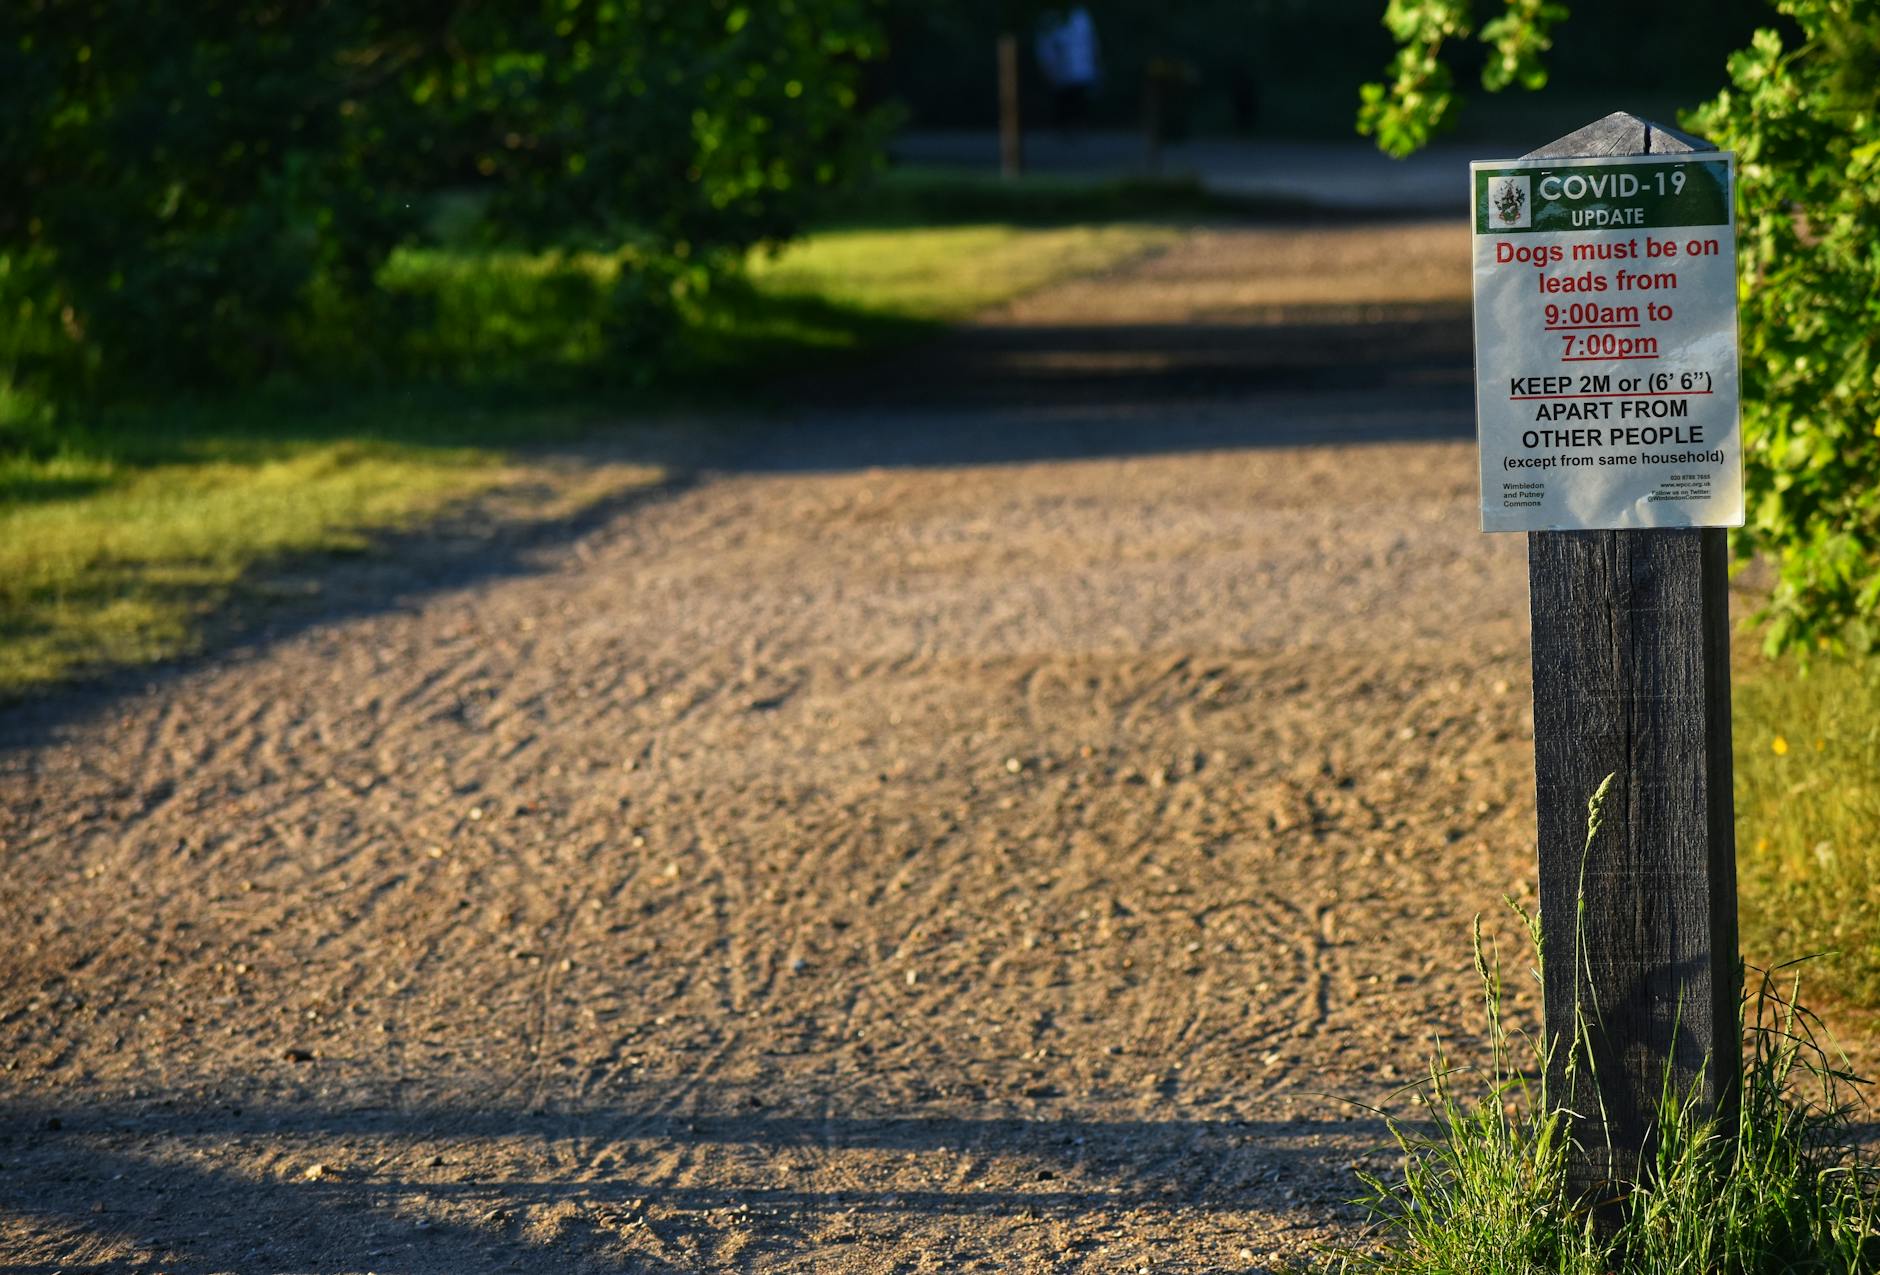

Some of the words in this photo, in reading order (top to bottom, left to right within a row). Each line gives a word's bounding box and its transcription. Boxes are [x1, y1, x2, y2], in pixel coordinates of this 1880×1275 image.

[1539, 171, 1687, 201] COVID-19
[1571, 208, 1644, 227] UPDATE
[1496, 241, 1564, 268] Dogs
[1572, 237, 1638, 261] must
[1646, 236, 1677, 258] be
[1686, 238, 1719, 257] on
[1539, 271, 1608, 294] leads
[1616, 269, 1677, 291] from
[1544, 303, 1639, 325] 9:00am
[1648, 302, 1673, 322] to
[1562, 333, 1658, 359] 7:00pm
[1510, 376, 1572, 396] KEEP
[1580, 375, 1610, 394] 2M
[1618, 376, 1642, 393] or
[1535, 402, 1613, 421] APART
[1621, 399, 1688, 419] FROM
[1522, 428, 1602, 449] OTHER
[1610, 425, 1704, 446] PEOPLE
[1503, 455, 1557, 471] (except
[1560, 454, 1594, 467] from
[1598, 454, 1637, 466] same
[1642, 449, 1724, 465] household)
[1502, 482, 1544, 490] Wimbledon
[1519, 491, 1545, 499] Putney
[1503, 500, 1541, 508] Commons
